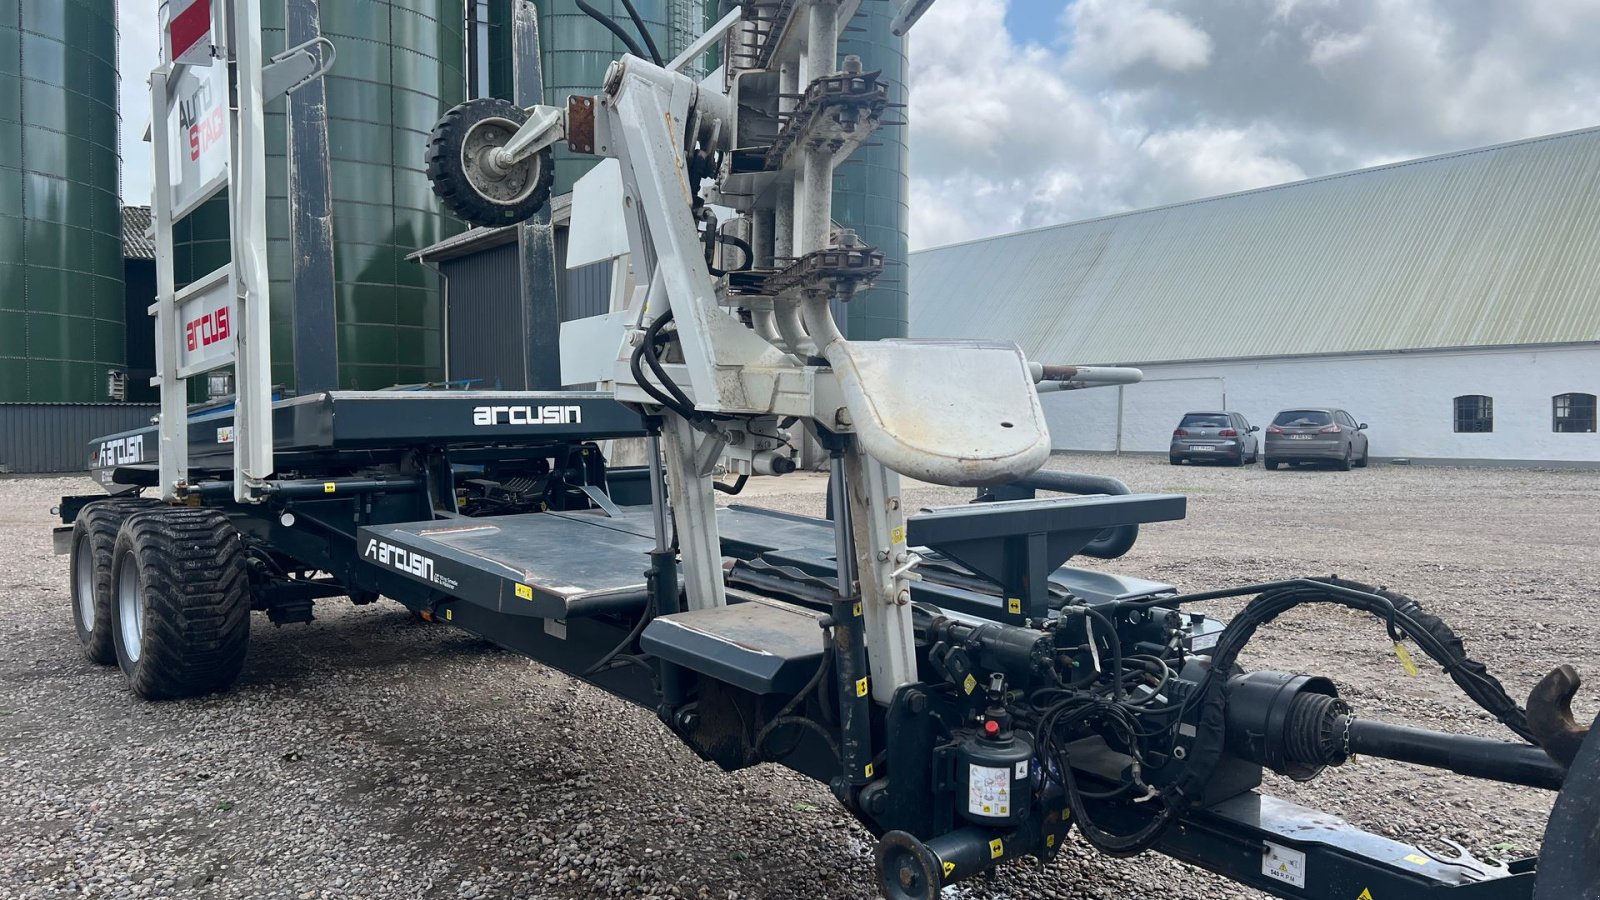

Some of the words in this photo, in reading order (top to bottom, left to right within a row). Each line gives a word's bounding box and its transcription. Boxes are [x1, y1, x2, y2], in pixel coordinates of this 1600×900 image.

[180, 76, 213, 130] AUTO
[189, 104, 224, 161] STAC
[186, 306, 230, 352] arcusi
[473, 405, 582, 426] arcusin
[379, 541, 434, 582] arcusin
